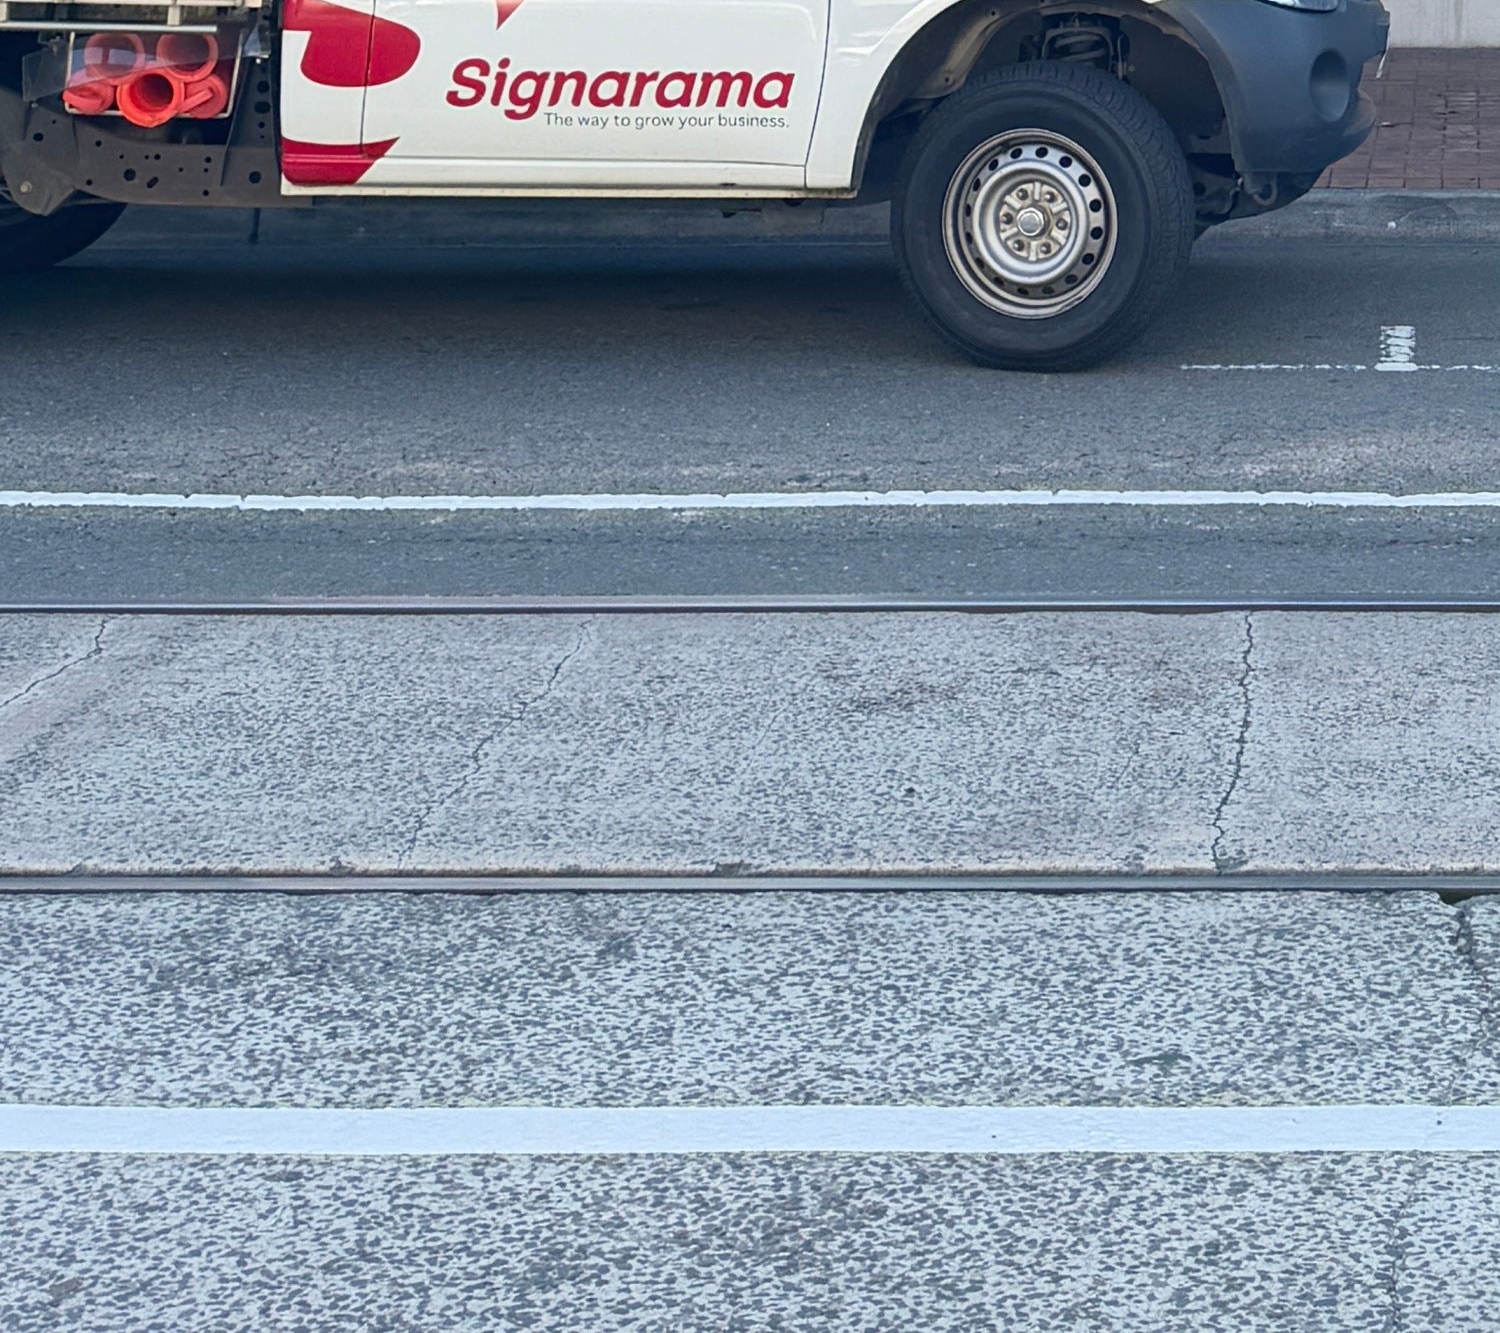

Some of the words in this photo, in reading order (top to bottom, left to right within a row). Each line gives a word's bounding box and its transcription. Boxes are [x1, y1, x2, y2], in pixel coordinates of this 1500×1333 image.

[445, 56, 796, 121] Signarama
[543, 112, 573, 127] The
[577, 115, 610, 130] way
[613, 114, 631, 127] to
[634, 115, 675, 131] grow
[678, 115, 715, 131] your
[717, 112, 790, 129] business.
